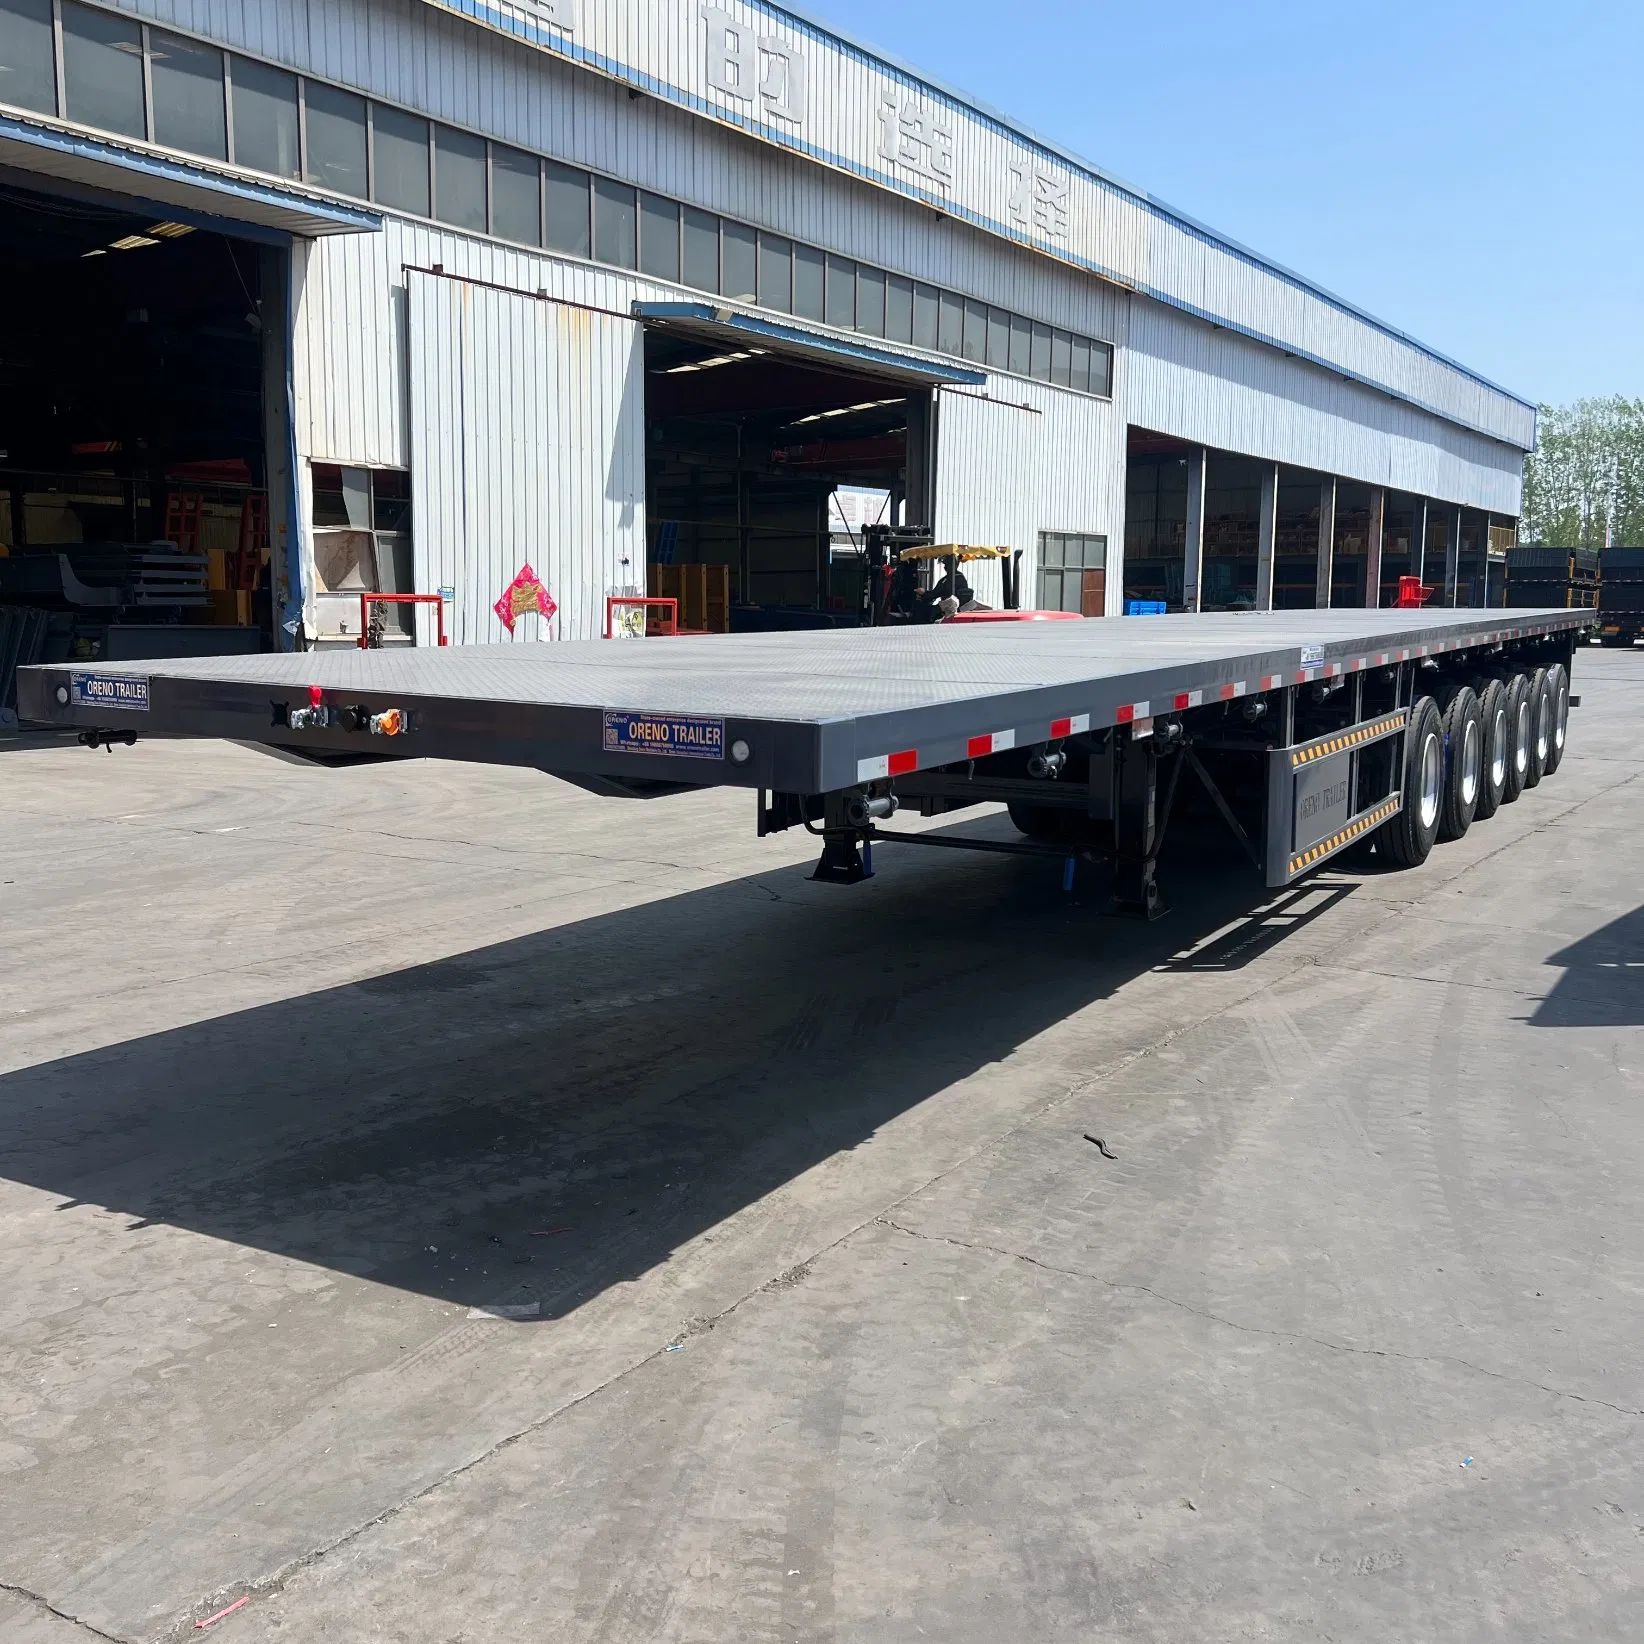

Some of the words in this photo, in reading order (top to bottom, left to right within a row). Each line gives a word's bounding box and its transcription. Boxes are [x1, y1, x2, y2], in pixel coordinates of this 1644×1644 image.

[87, 680, 114, 697] ORENO
[115, 683, 147, 699] TRAILER
[628, 721, 669, 741] ORENO
[672, 724, 721, 745] TRAILER
[1322, 780, 1347, 810] TRAILER
